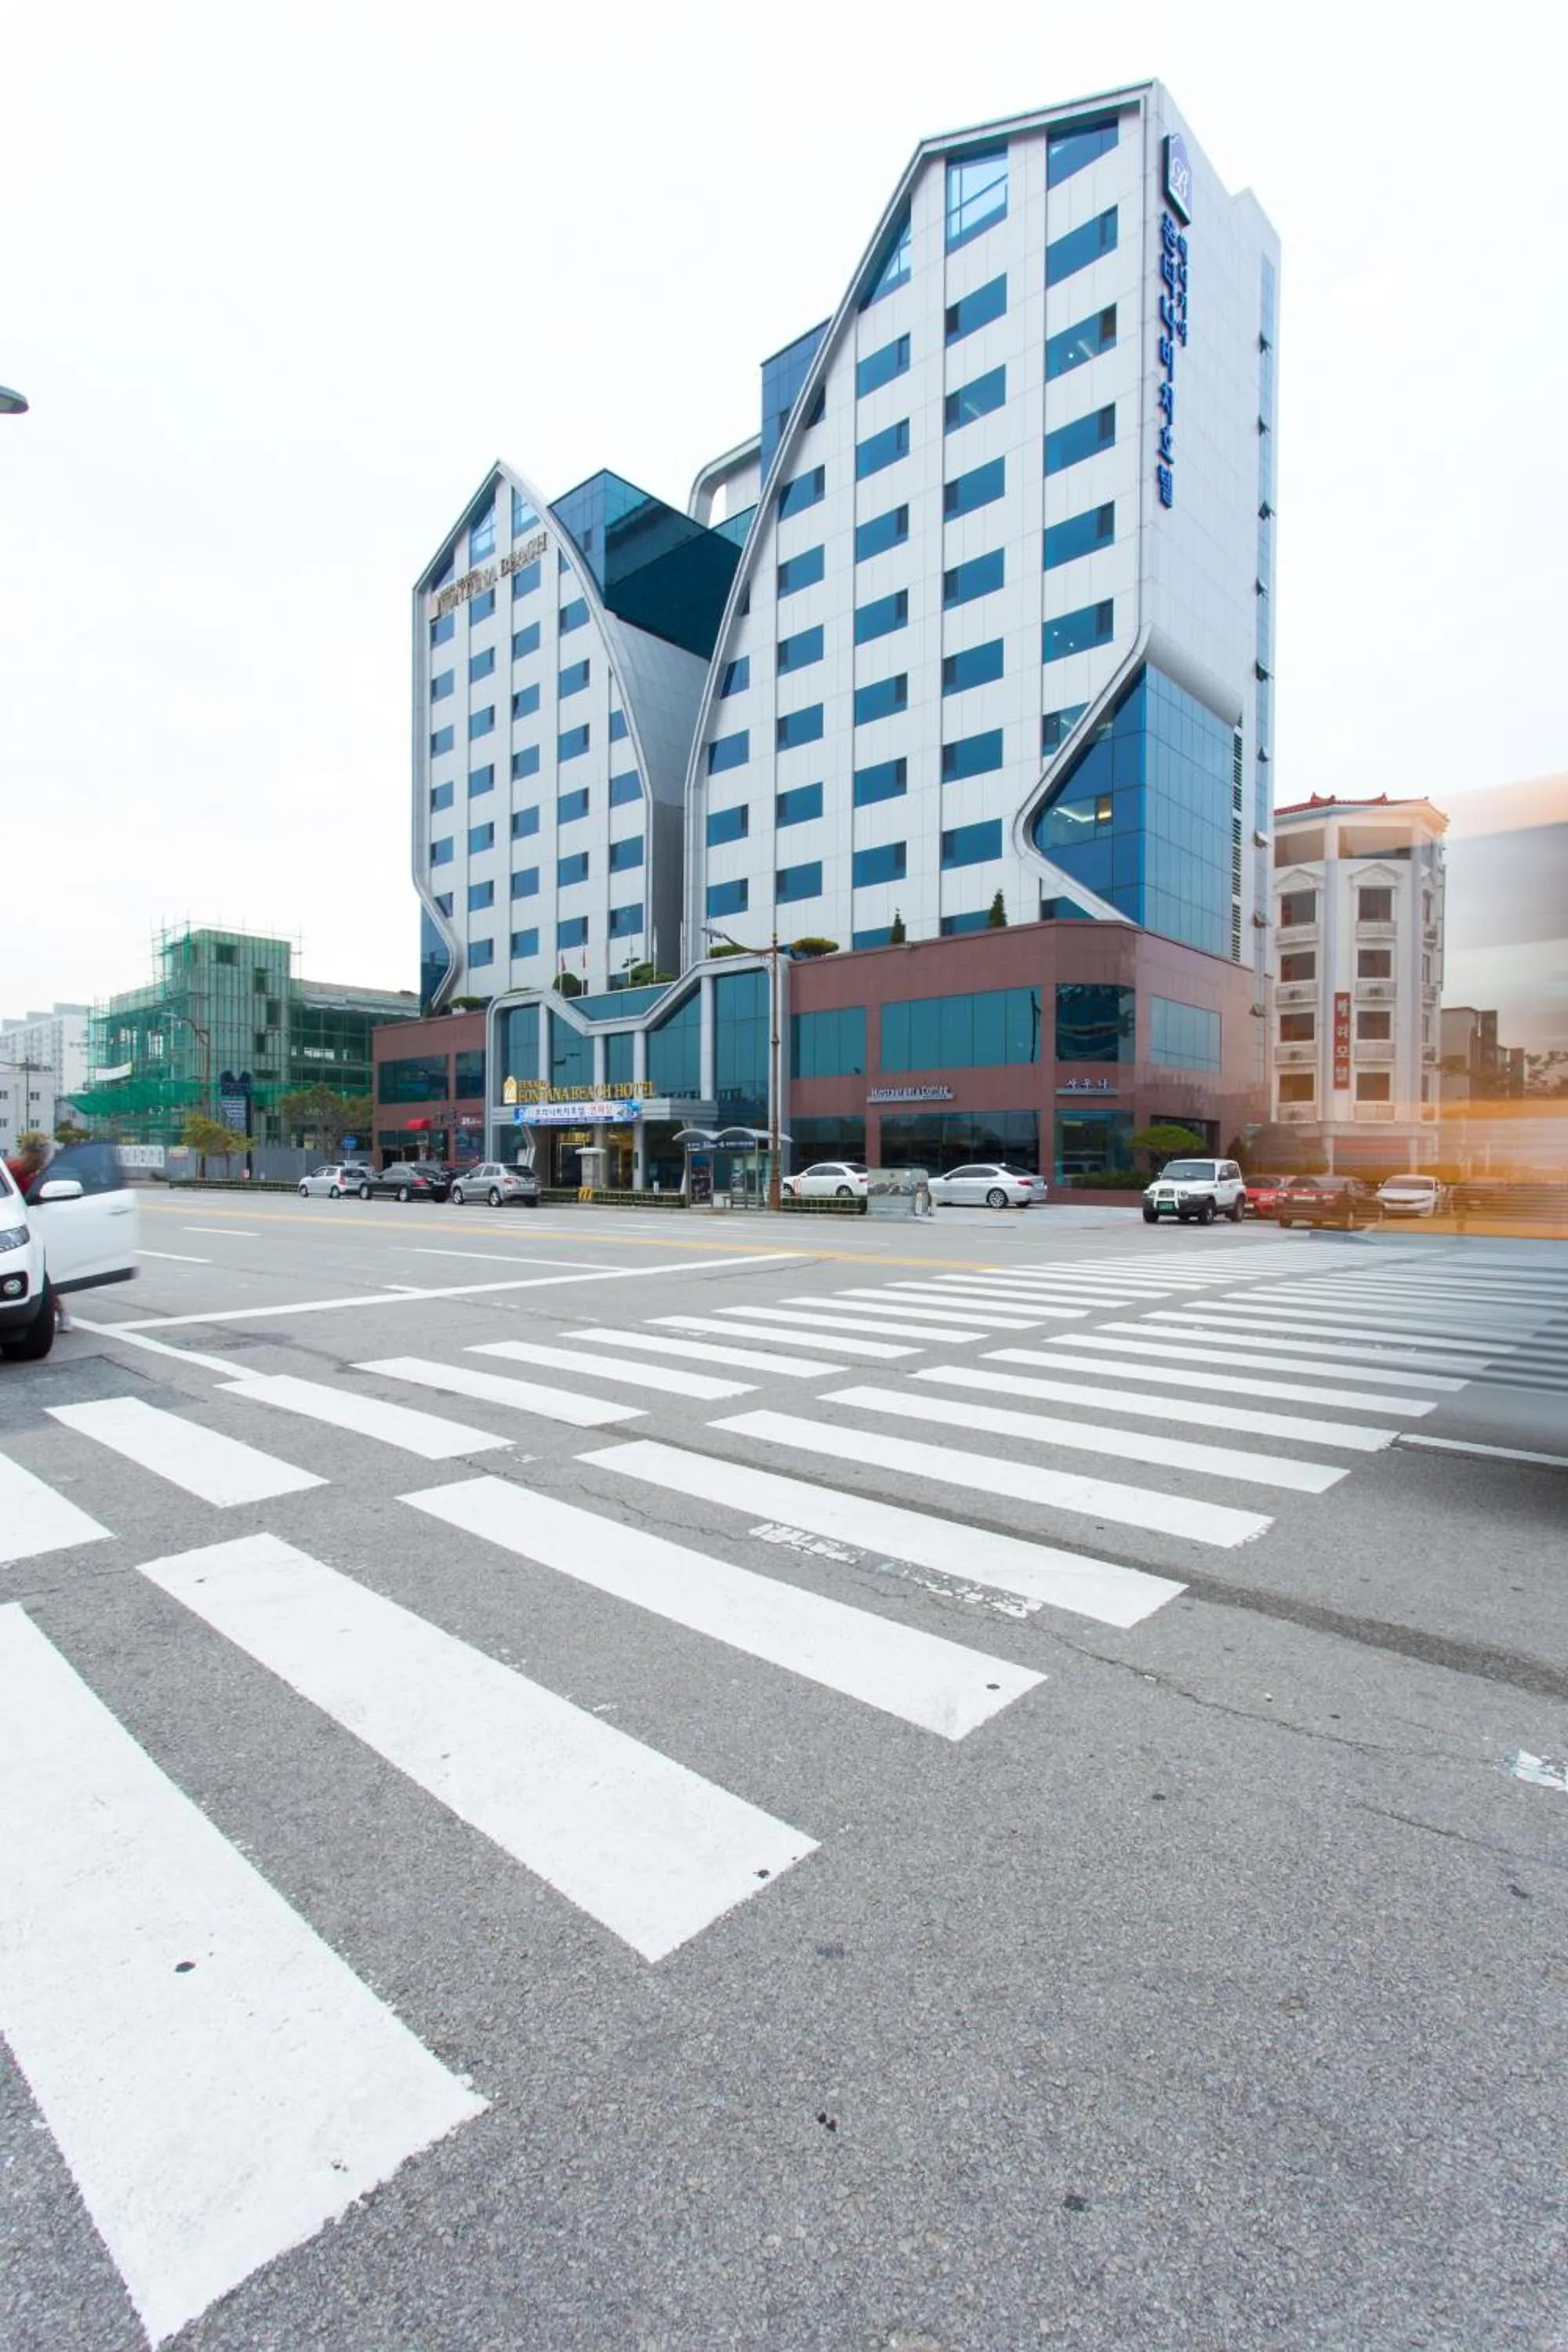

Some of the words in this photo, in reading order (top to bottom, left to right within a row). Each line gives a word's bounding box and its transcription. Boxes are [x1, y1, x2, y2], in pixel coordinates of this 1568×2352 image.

[518, 1085, 569, 1102] FONTANA
[571, 1083, 612, 1100] BEACH
[613, 1081, 654, 1098] HOTEL
